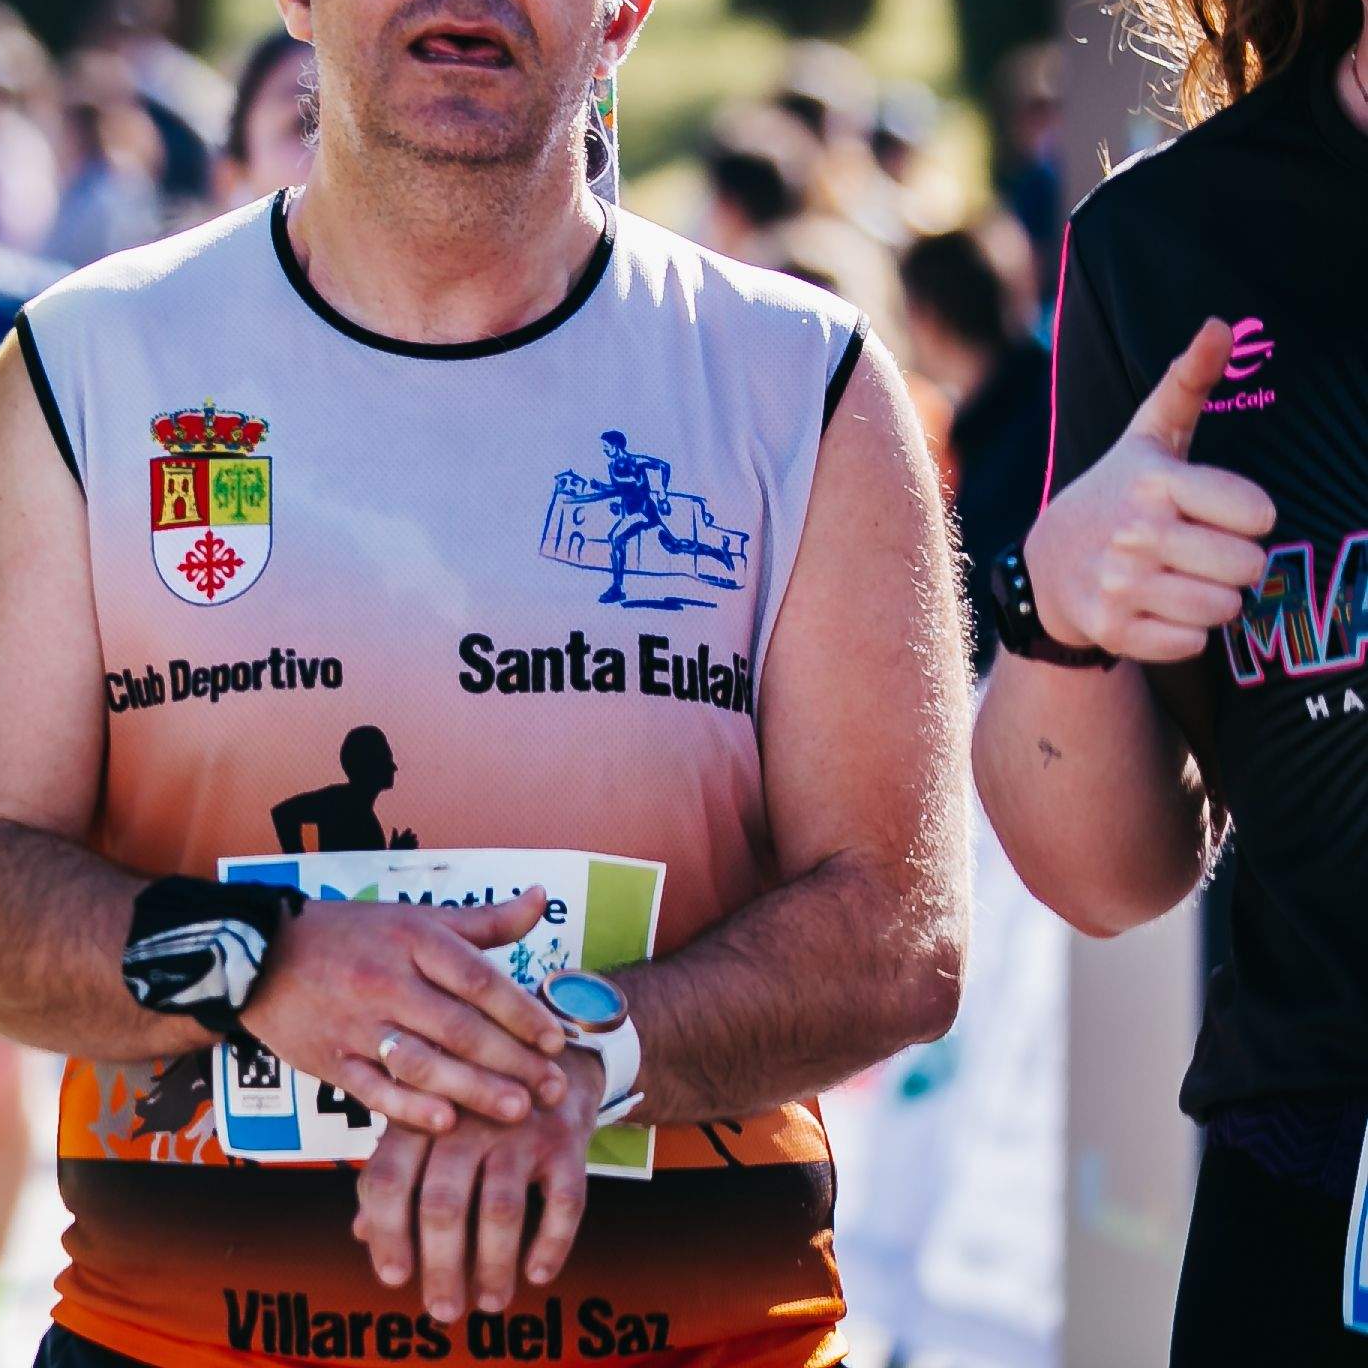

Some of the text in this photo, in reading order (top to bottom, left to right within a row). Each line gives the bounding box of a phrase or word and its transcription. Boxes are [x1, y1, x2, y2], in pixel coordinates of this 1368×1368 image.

[104, 646, 344, 714] Club Deportivo
[458, 630, 627, 695] Santa
[223, 1287, 453, 1360] Villares
[576, 1296, 676, 1360] Saz
